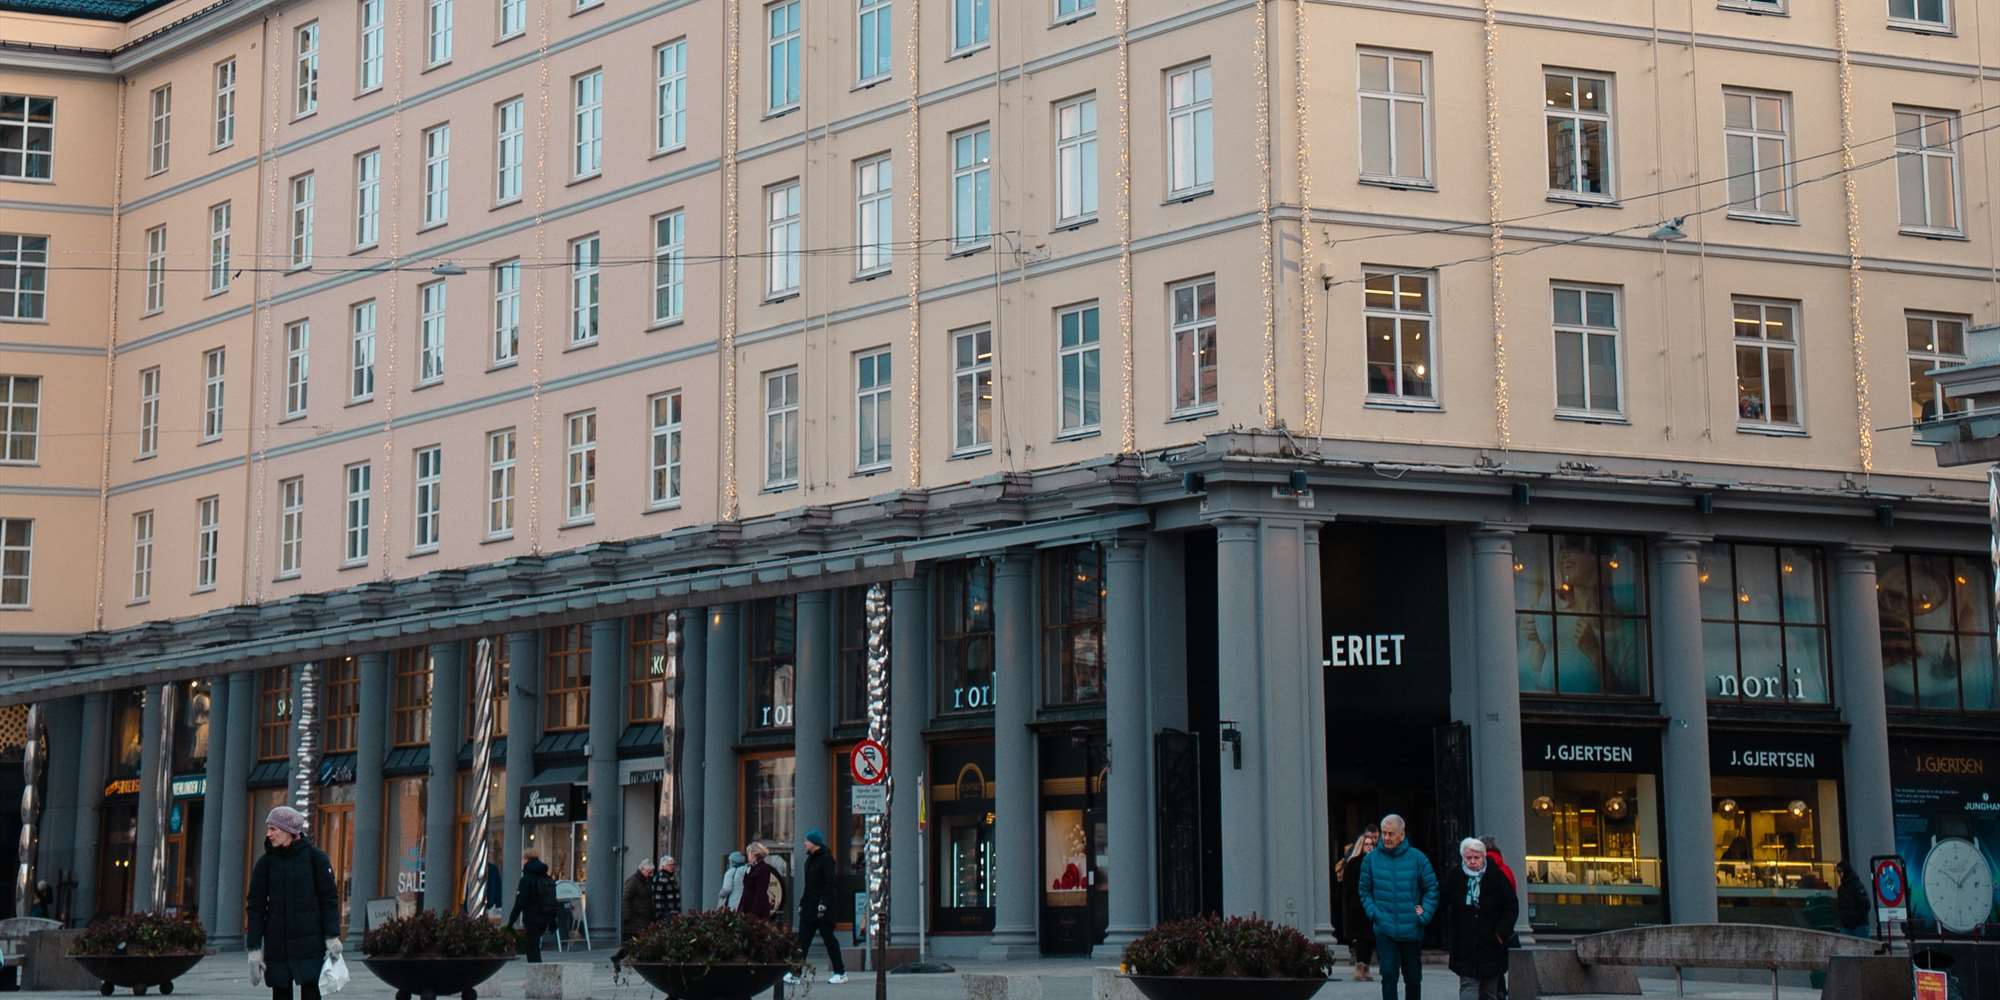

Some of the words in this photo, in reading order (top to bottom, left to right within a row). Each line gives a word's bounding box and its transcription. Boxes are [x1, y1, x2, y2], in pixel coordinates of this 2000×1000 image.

[1717, 663, 1806, 699] nori
[1558, 744, 1632, 762] GJERTSEN
[1743, 751, 1815, 768] GJERTSEN
[1925, 756, 1983, 775] GJERTSEN
[398, 871, 426, 893] SALE
